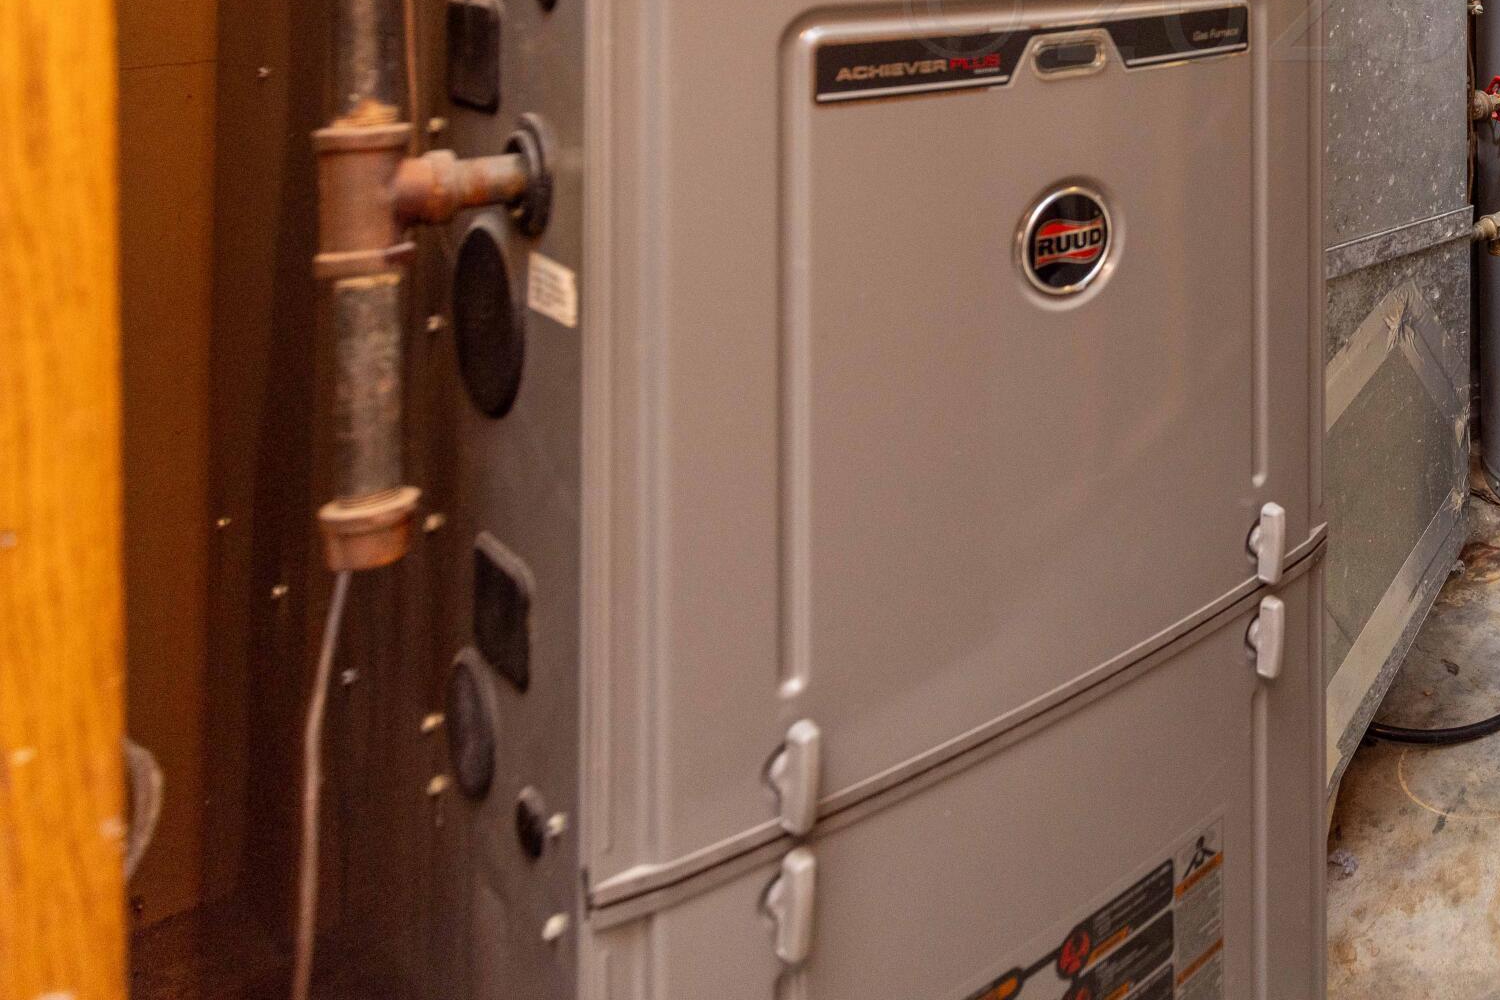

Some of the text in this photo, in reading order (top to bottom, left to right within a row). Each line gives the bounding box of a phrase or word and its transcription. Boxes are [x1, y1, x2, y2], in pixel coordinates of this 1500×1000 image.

[835, 53, 1000, 82] ACHIEVER PLUS
[1038, 228, 1101, 256] RUUD
